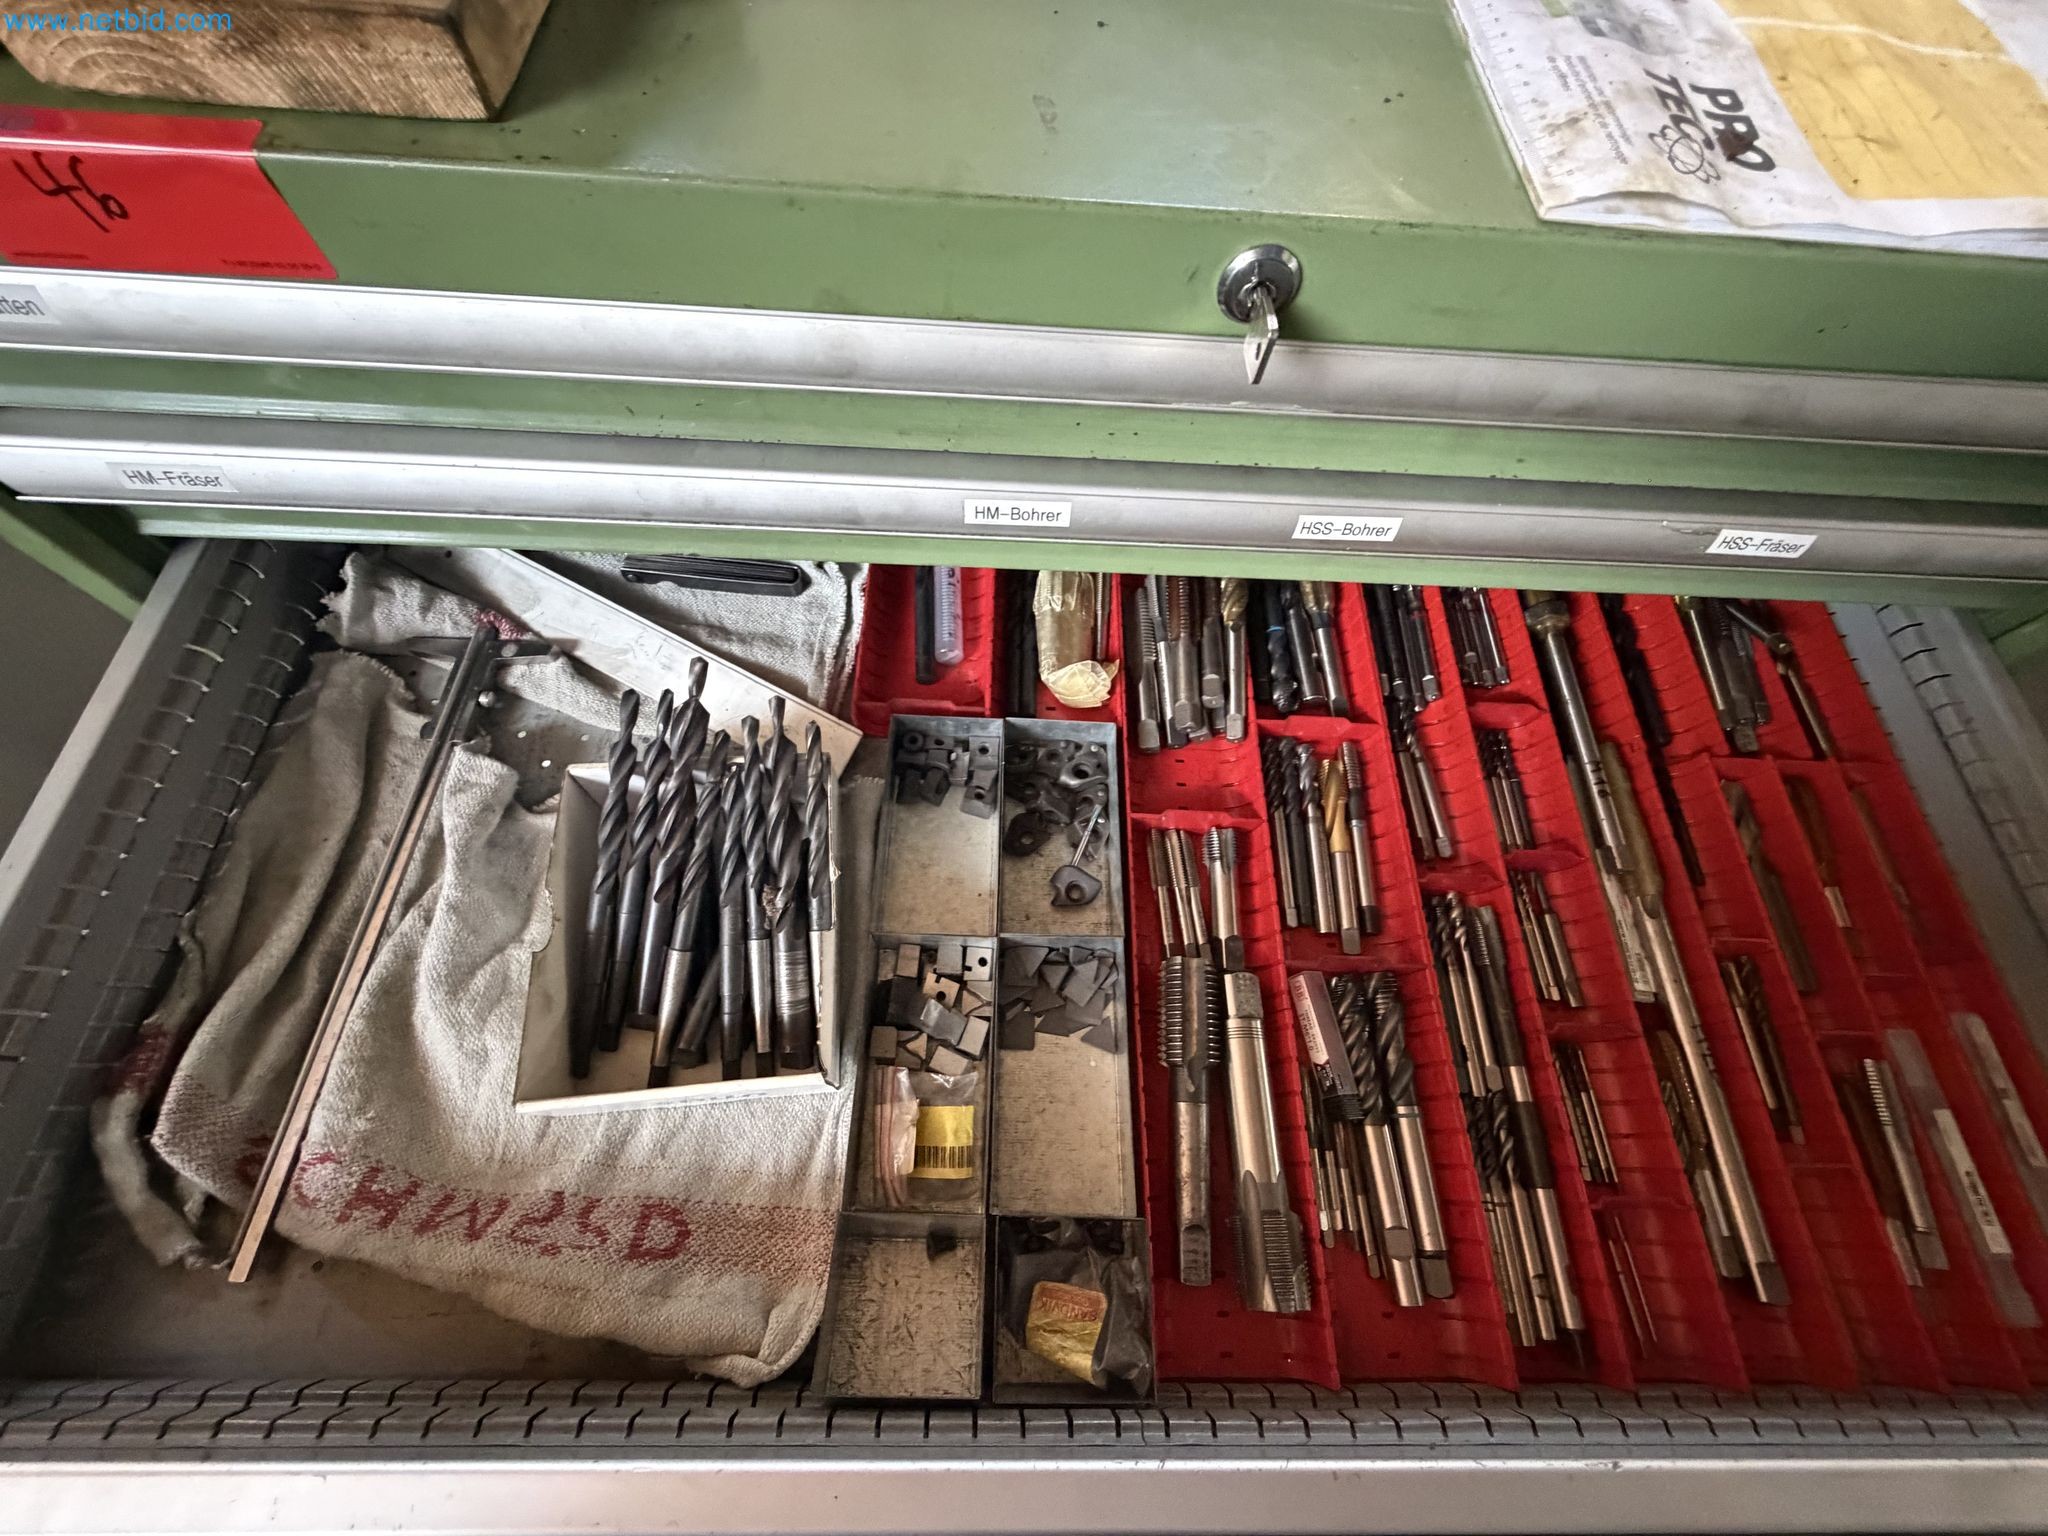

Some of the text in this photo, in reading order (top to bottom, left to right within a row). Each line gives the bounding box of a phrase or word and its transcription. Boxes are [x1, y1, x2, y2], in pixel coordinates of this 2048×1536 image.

[1643, 68, 1715, 151] TEC
[12, 150, 129, 233] 46
[122, 470, 223, 487] HM-Fräser
[975, 506, 1062, 522] HM-Bohrer
[1300, 521, 1392, 537] HSS-Bohrer
[1718, 536, 1805, 554] HSS-Fräser
